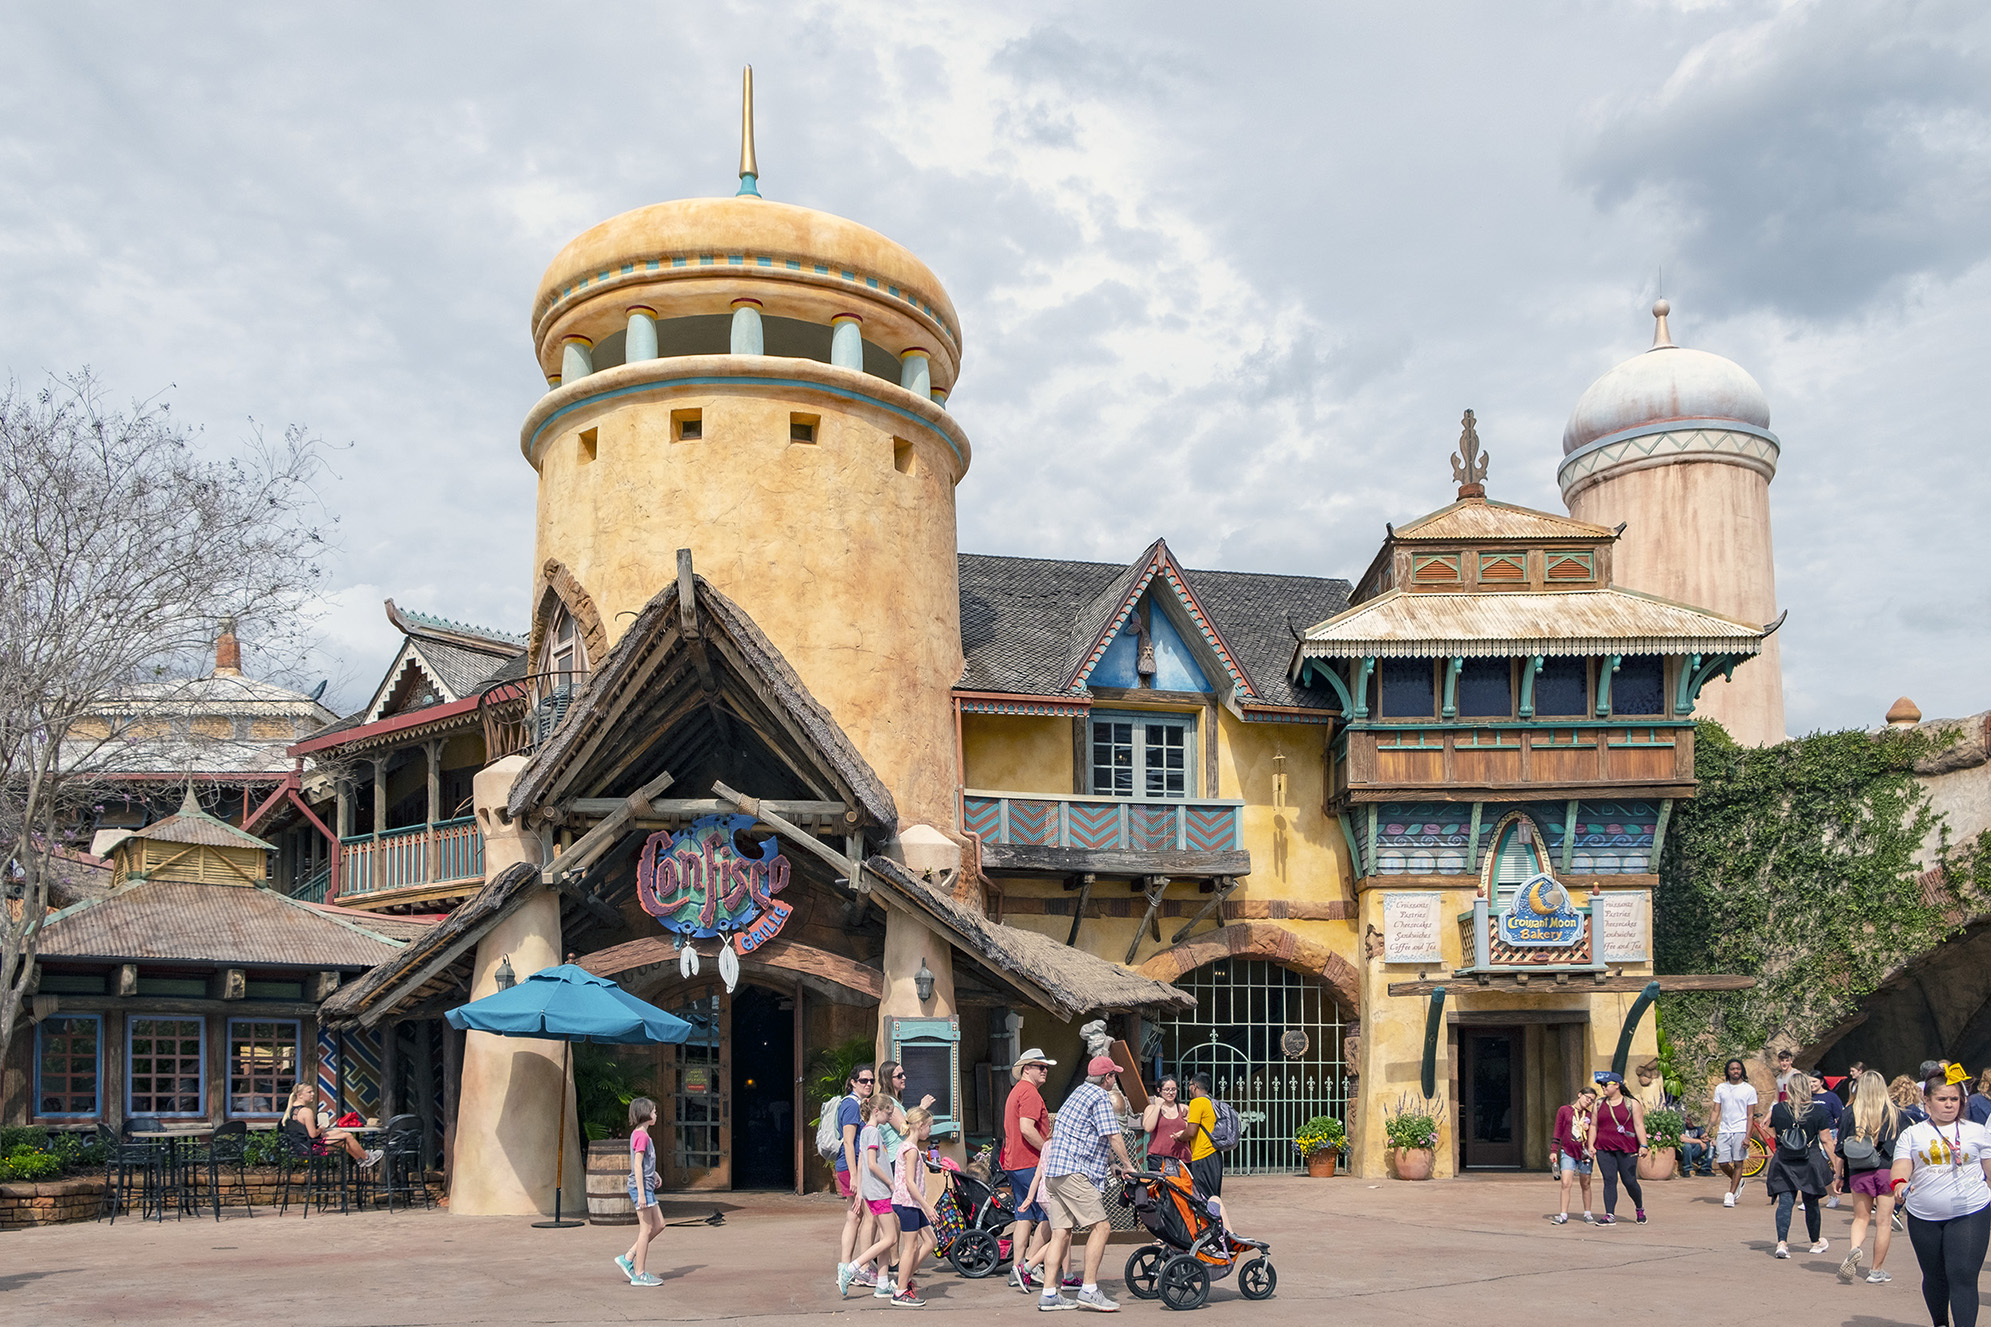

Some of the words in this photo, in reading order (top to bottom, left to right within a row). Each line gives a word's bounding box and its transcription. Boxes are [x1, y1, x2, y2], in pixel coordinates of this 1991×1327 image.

[637, 830, 791, 928] Confisco
[1395, 901, 1429, 909] Croissants
[1400, 911, 1426, 919] Pastries
[741, 906, 788, 950] GRILLE
[1393, 920, 1432, 930] Cheesecakes
[1507, 916, 1549, 929] Croissant
[1549, 917, 1576, 929] Moon
[1604, 919, 1637, 929] heesecakes
[1394, 931, 1431, 942] Sandwiches
[1520, 928, 1563, 942] Bakery
[1604, 930, 1637, 938] andwiches
[1390, 942, 1411, 954] Coffee
[1412, 942, 1424, 951] and
[1425, 941, 1437, 952] Tea
[1617, 942, 1630, 950] and
[1630, 940, 1642, 951] Tea
